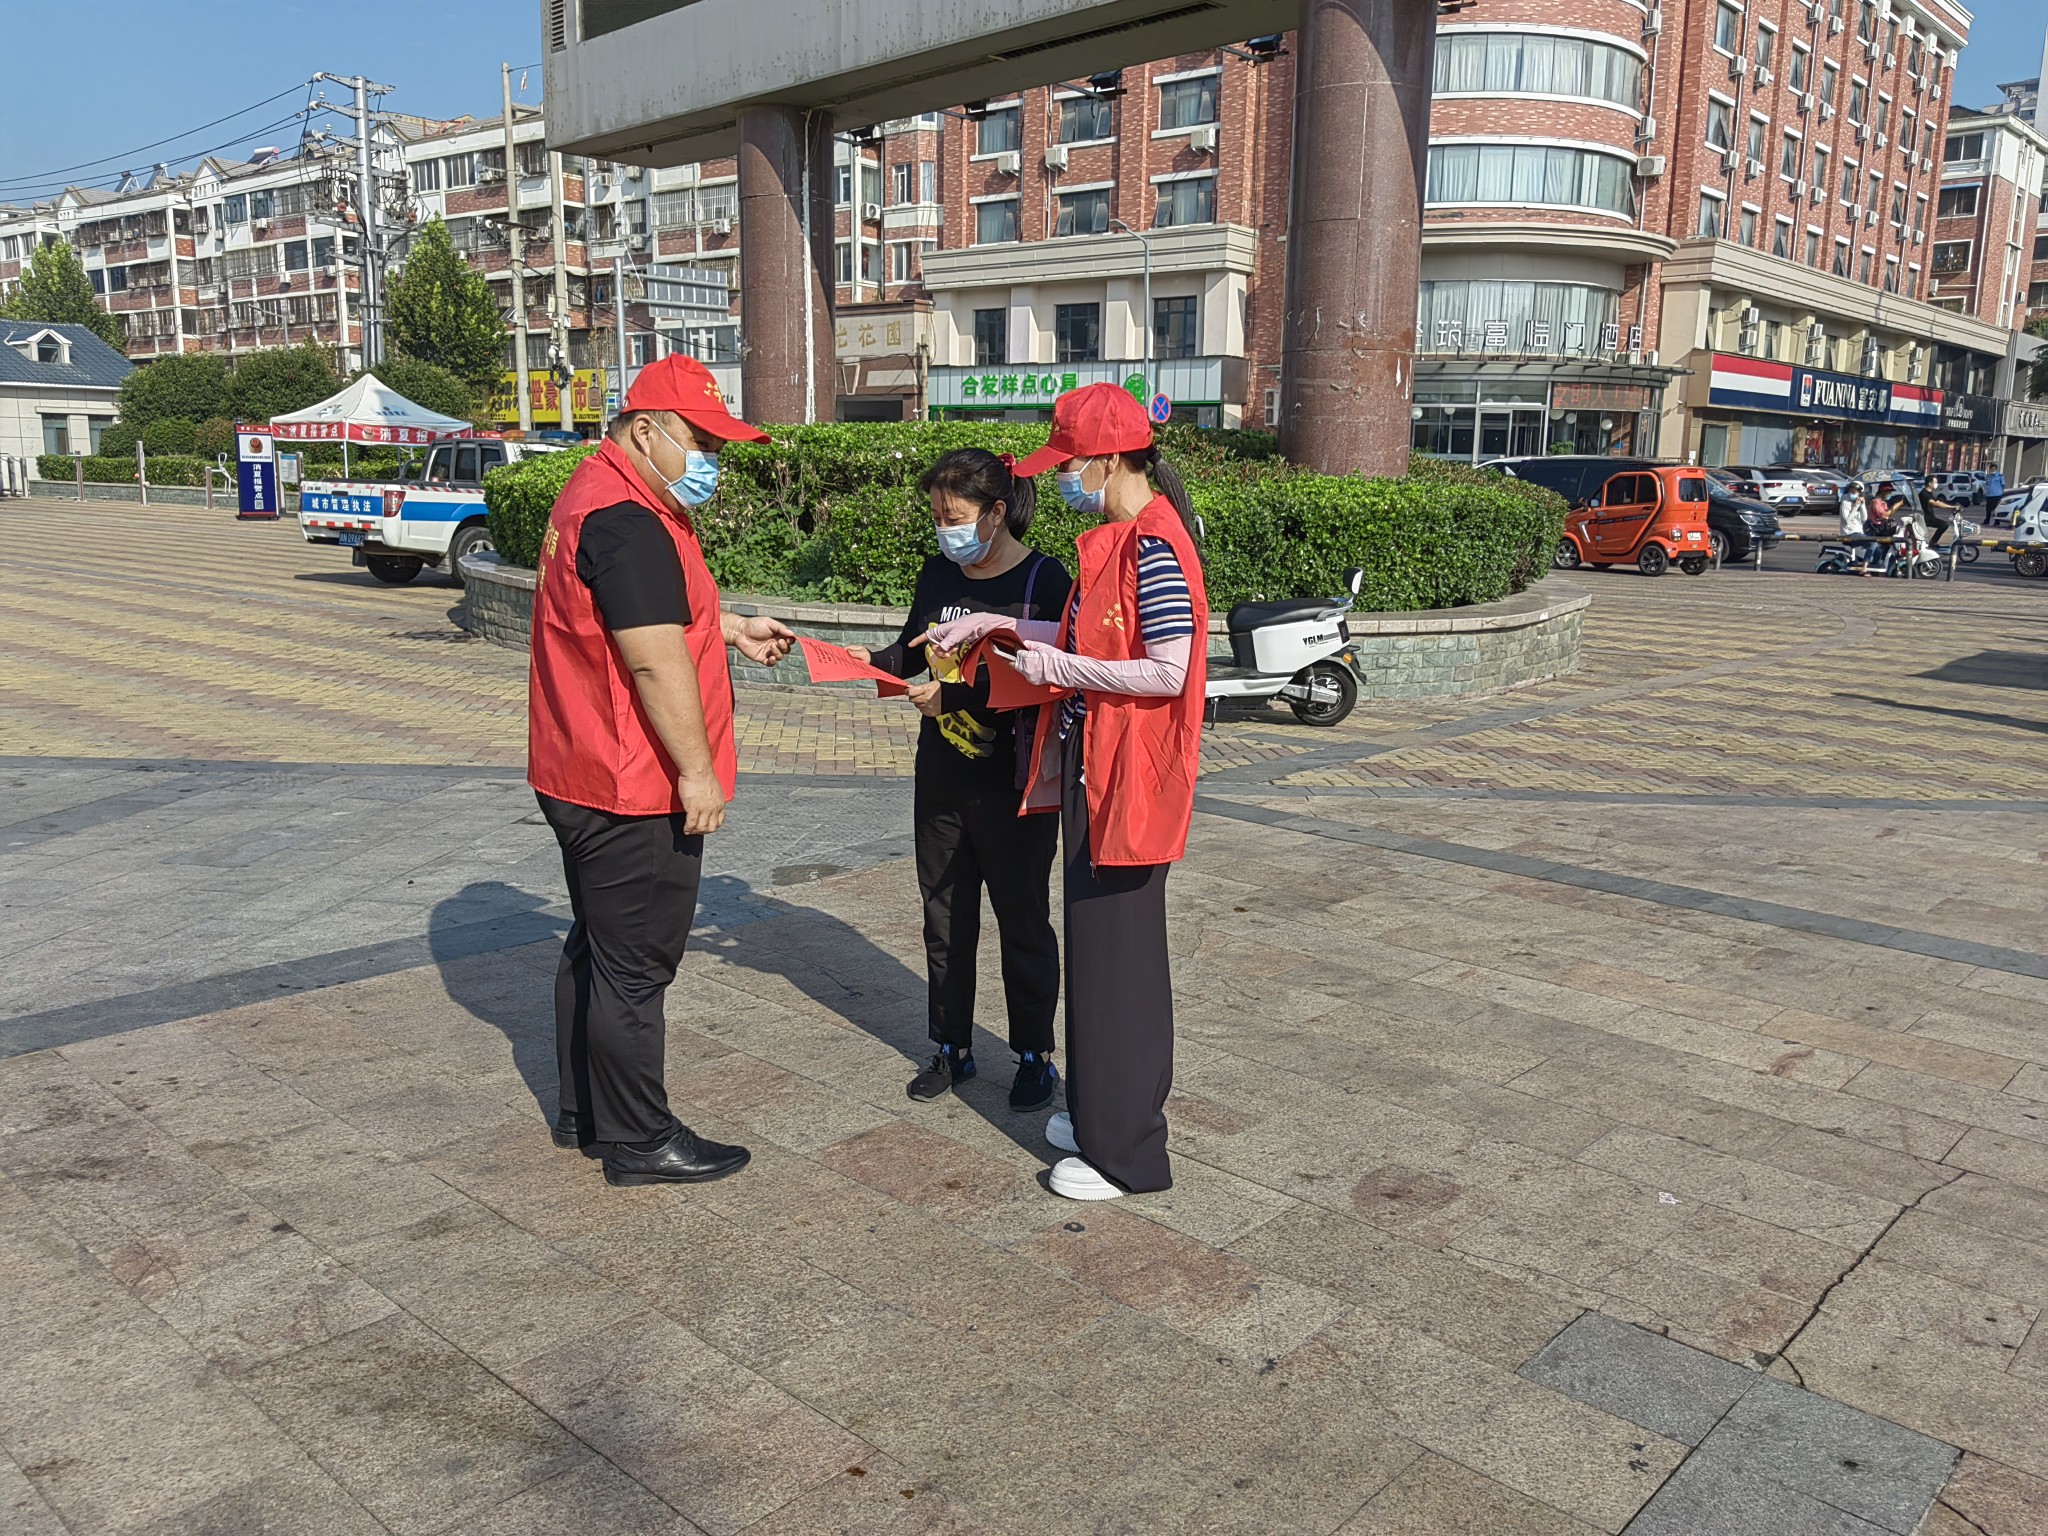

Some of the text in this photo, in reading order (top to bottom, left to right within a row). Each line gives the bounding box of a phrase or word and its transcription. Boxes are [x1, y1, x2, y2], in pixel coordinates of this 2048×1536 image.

[530, 376, 588, 411] 世豪市
[1813, 379, 1856, 409] FUANNA
[289, 424, 338, 438] 消夏报警点
[252, 463, 264, 500] 消夏报警点
[311, 497, 371, 512] 城市管理执法
